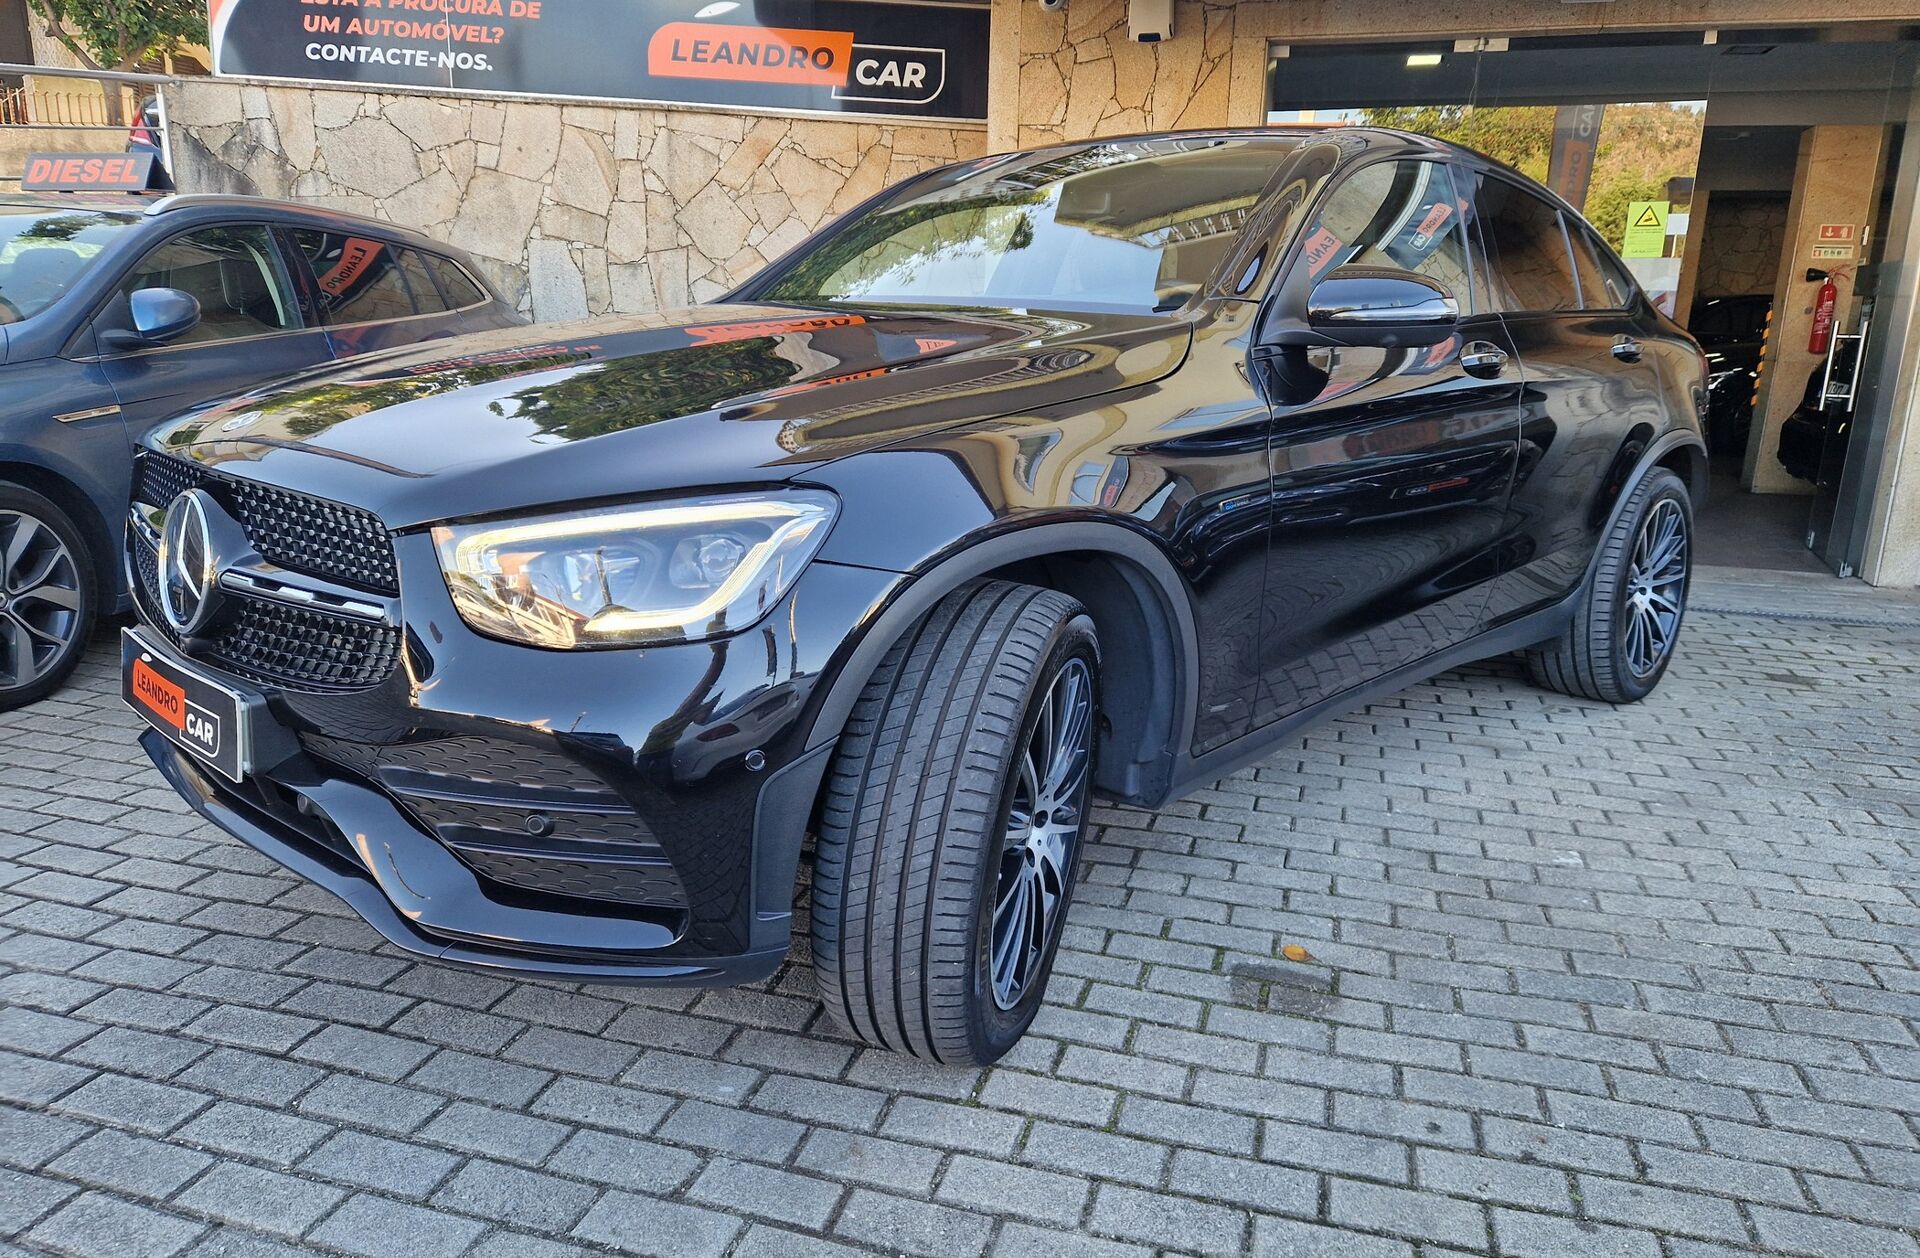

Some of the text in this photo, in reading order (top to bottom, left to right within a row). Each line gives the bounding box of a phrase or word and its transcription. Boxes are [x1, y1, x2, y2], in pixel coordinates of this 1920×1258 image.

[509, 1, 542, 19] DE
[303, 14, 505, 44] UM AUTOMÓVEL?
[305, 43, 493, 71] CONTACTE-NOS.
[671, 39, 927, 88] LEANDRO CAR
[27, 159, 140, 184] DIESEL
[136, 669, 214, 746] LEANDRO CAR
